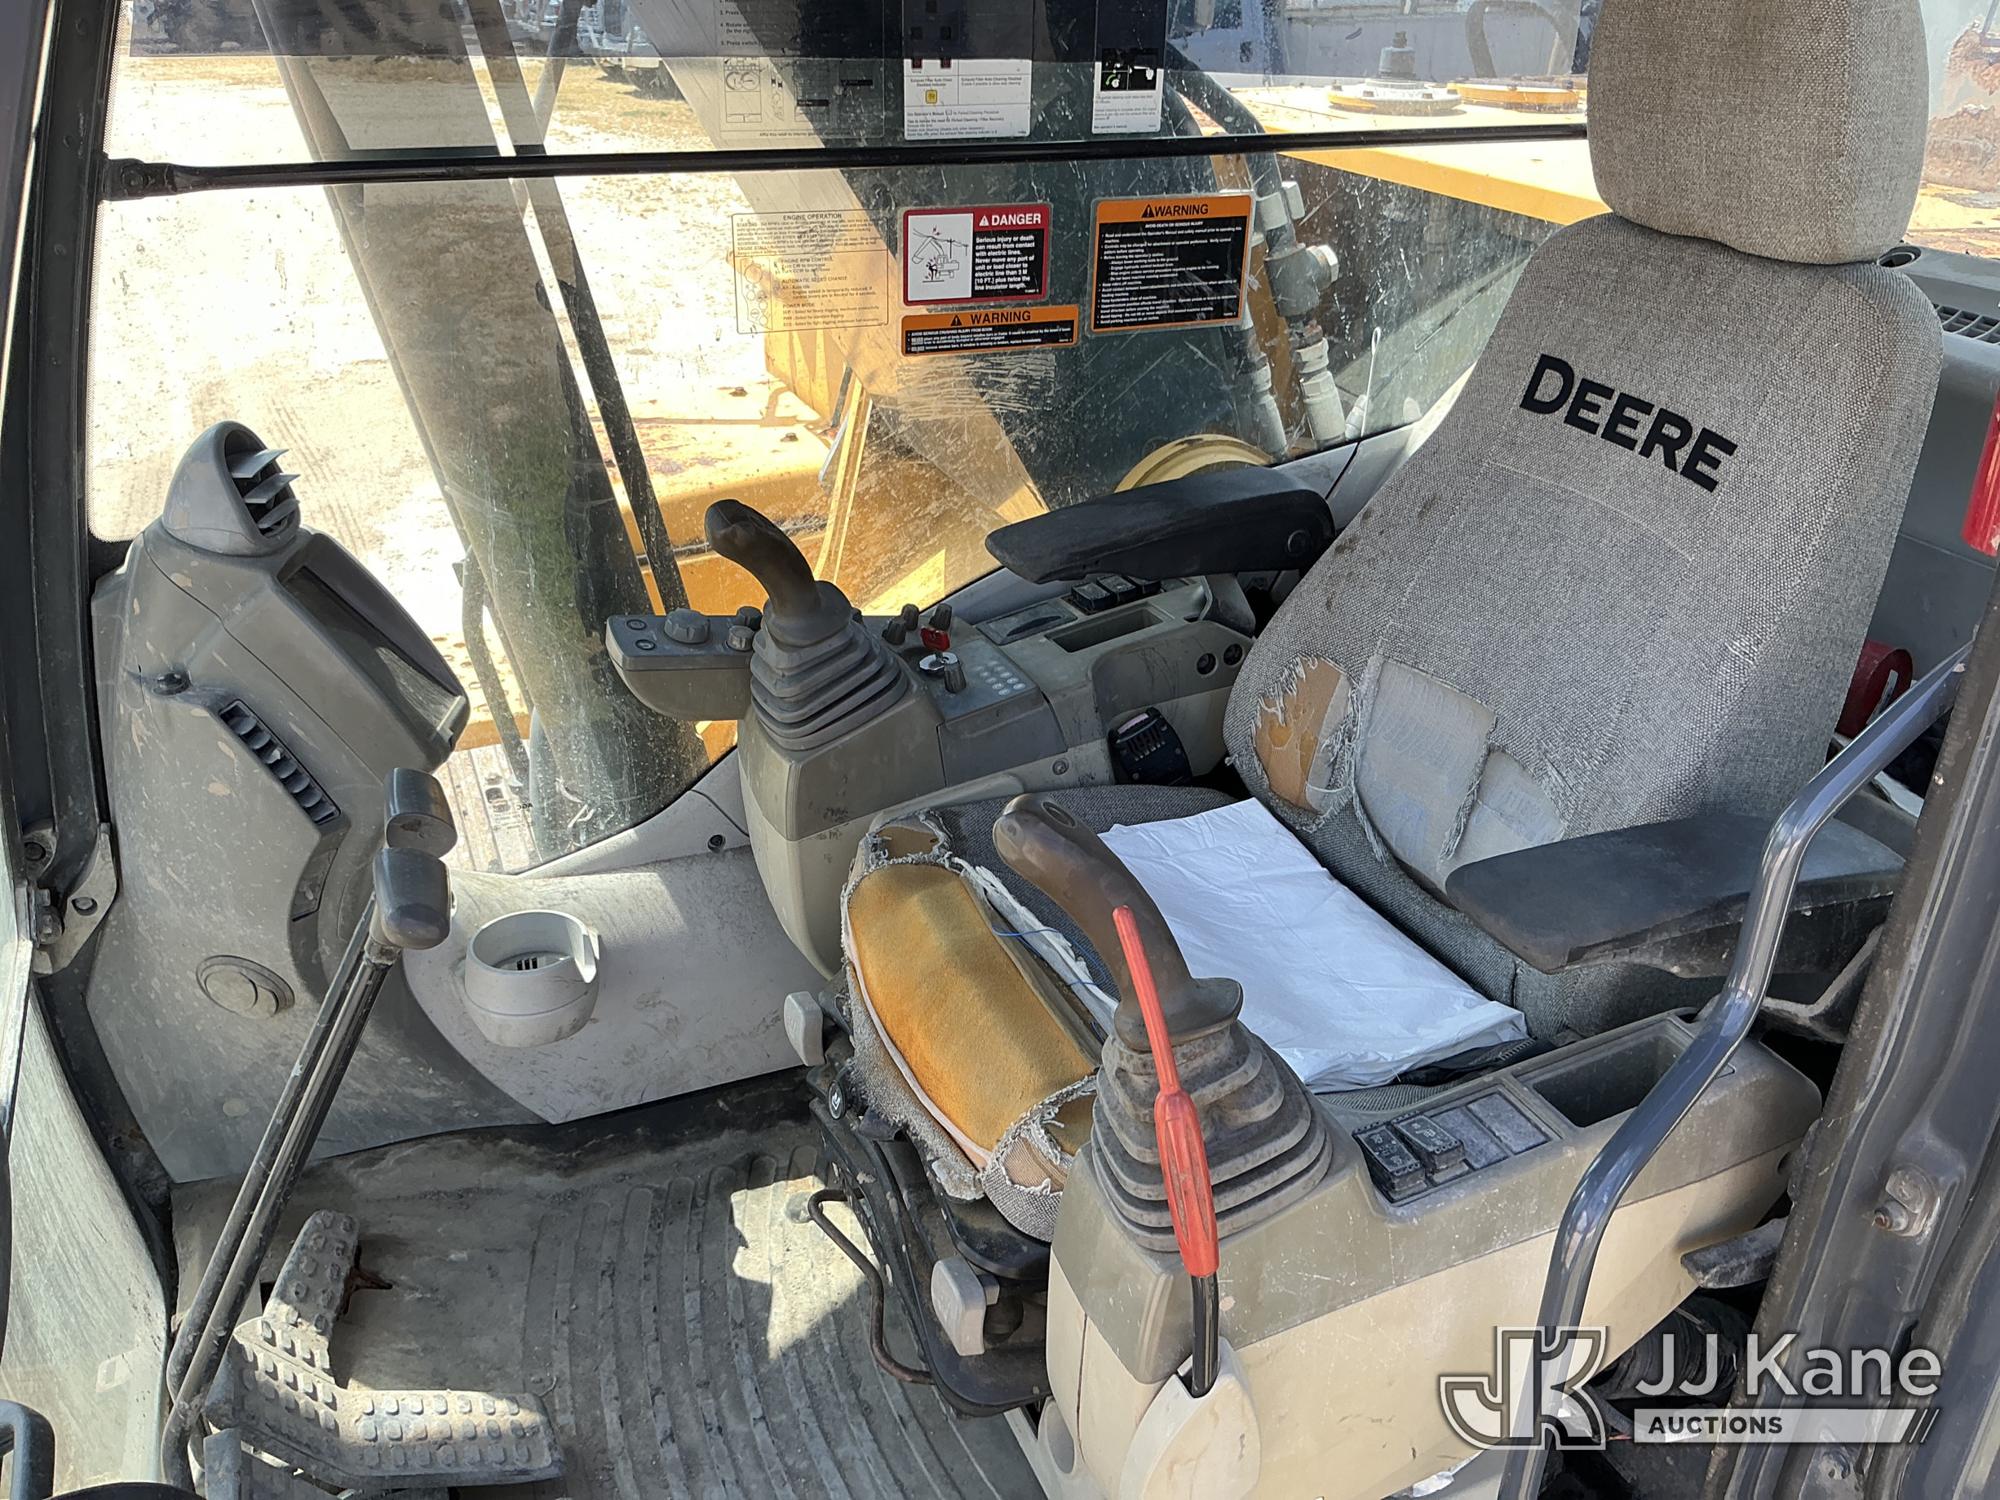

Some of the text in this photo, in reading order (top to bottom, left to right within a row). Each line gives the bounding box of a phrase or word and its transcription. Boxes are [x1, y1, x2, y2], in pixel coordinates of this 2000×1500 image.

[1154, 204, 1208, 217] WARNING
[991, 213, 1041, 226] DANGER
[995, 276, 1006, 284] plus
[970, 311, 1031, 325] WARNING
[1519, 354, 1738, 493] DEERE
